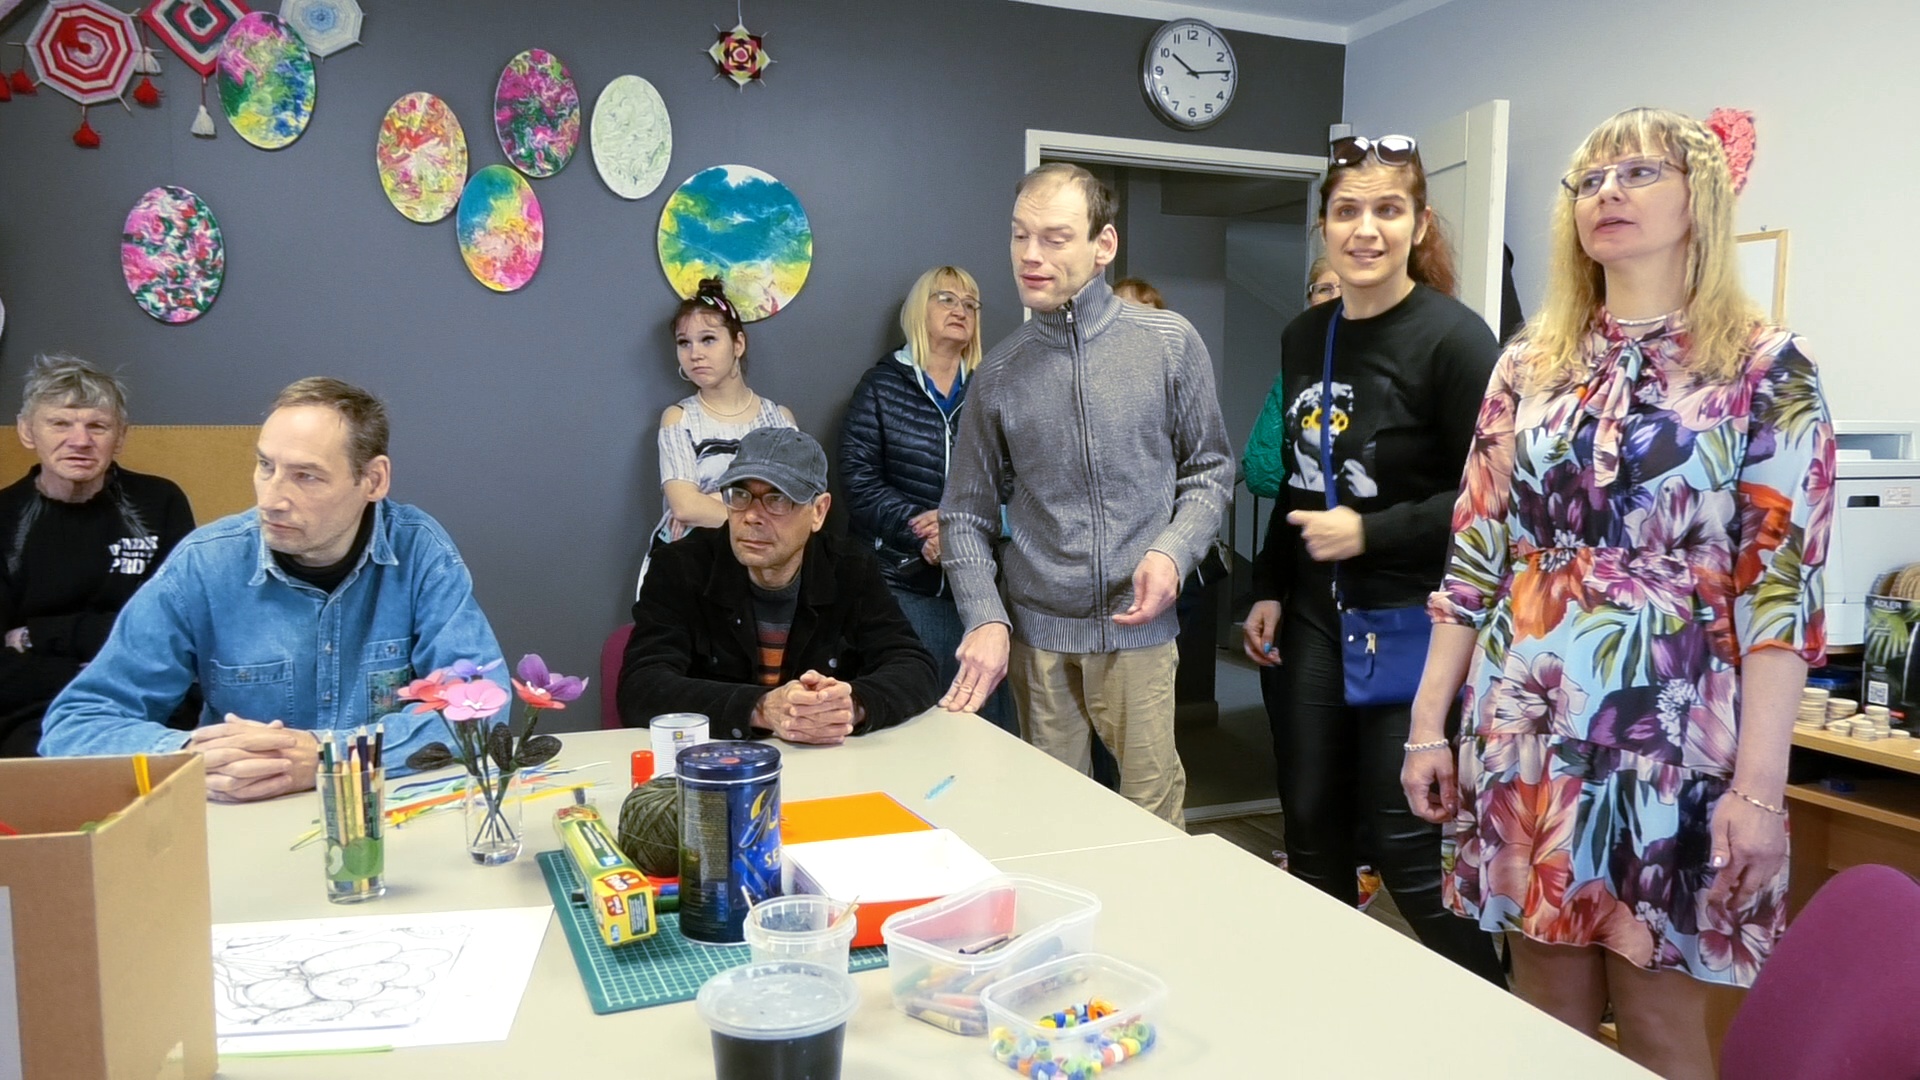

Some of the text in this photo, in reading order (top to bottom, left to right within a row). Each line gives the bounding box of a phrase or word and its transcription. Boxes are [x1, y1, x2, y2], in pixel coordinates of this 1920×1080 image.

[1173, 34, 1181, 44] 11
[1187, 30, 1199, 40] 12
[1208, 37, 1212, 47] 1
[1160, 48, 1170, 58] 10
[1216, 52, 1225, 62] 2
[1154, 66, 1164, 76] 9
[1220, 71, 1230, 82] 3
[1216, 91, 1224, 100] 4
[1172, 101, 1180, 111] 7
[1204, 103, 1214, 113] 5
[1188, 108, 1197, 118] 6
[1873, 599, 1902, 610] ADLER
